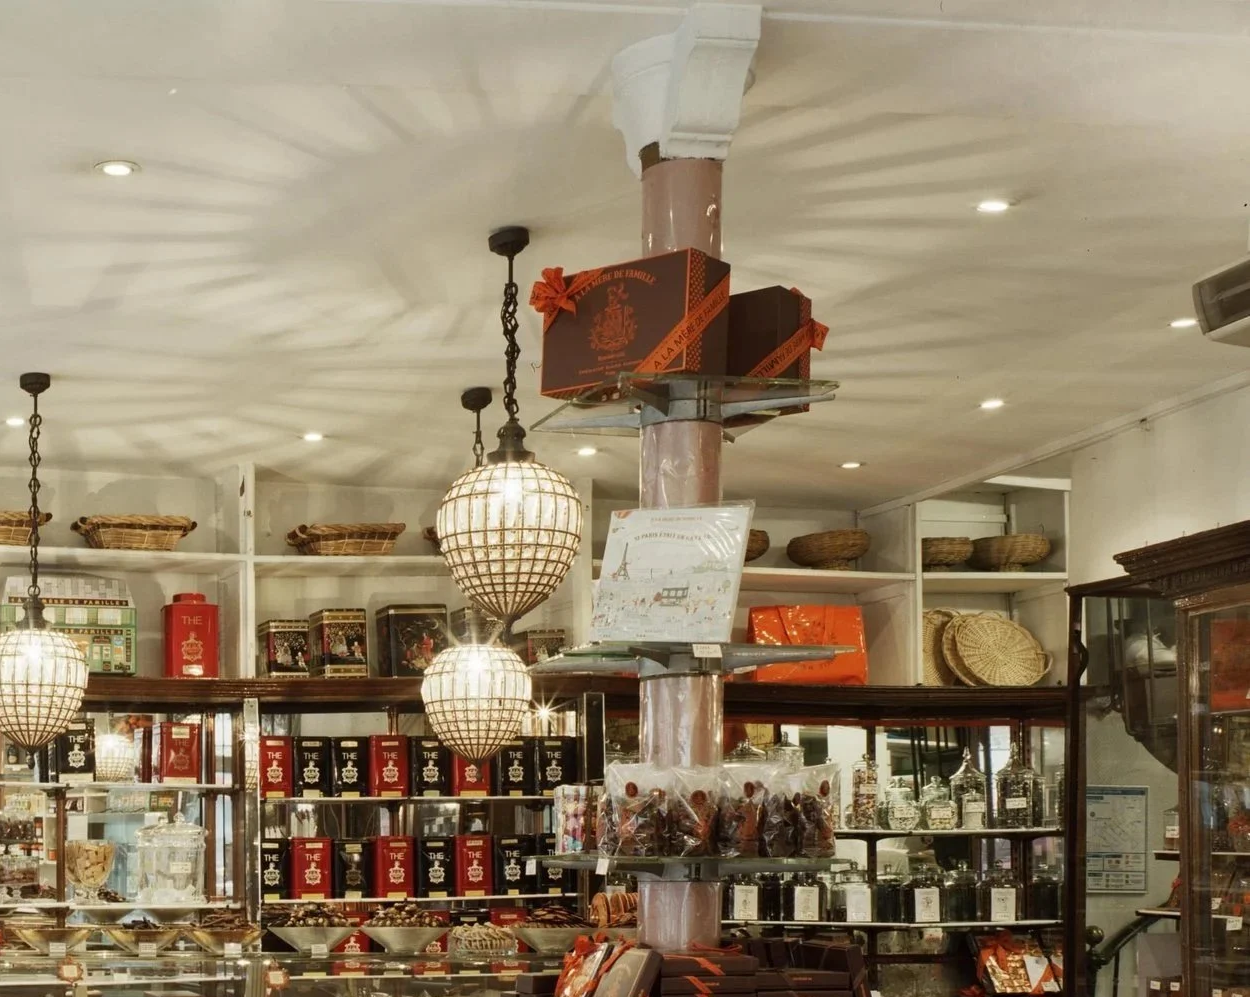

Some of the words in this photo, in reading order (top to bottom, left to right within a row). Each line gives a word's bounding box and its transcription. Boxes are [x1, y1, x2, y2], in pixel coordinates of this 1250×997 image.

[181, 615, 203, 626] THE
[68, 735, 85, 744] THE
[266, 751, 283, 760] THE
[303, 752, 320, 761] THE
[342, 752, 358, 760] THE
[382, 751, 398, 760] THE
[422, 751, 439, 760] THE
[508, 751, 524, 759] THE
[546, 751, 562, 759] THE
[264, 853, 280, 862] THE
[305, 853, 322, 862] THE
[389, 852, 406, 861] THE
[467, 851, 483, 859] THE
[504, 850, 521, 858] THE
